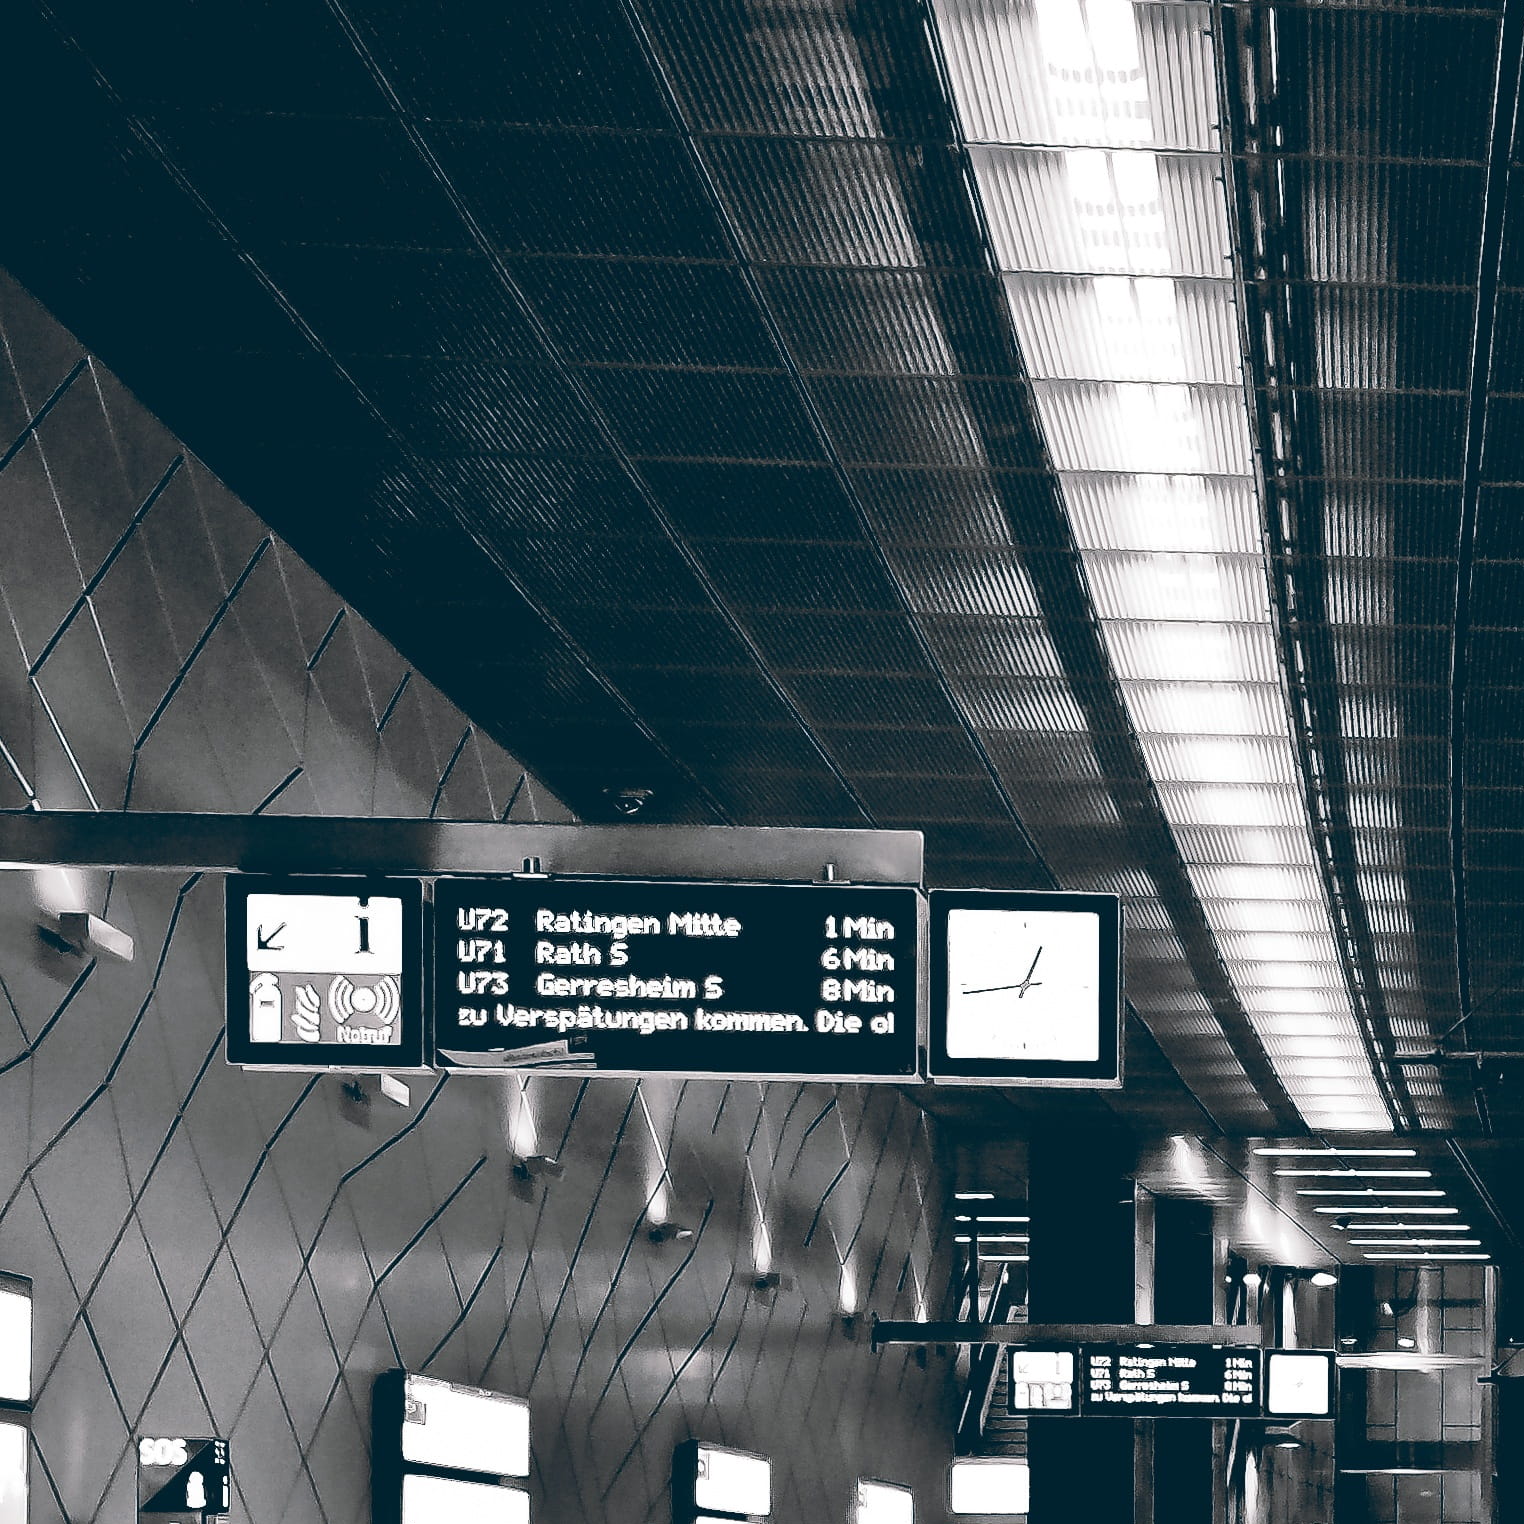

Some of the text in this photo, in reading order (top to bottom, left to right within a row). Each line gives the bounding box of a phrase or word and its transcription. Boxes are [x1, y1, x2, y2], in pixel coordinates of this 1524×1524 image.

[458, 908, 894, 939] U72 Ratingen Mitte 1 Min
[458, 939, 894, 970] U71 Rath S 6 Min
[459, 971, 509, 995] U73
[536, 973, 697, 998] Gerresheim
[704, 975, 724, 999] S
[843, 979, 894, 1002] Min
[458, 1008, 487, 1026] zu
[496, 1003, 688, 1034] Verspätungen
[694, 1008, 809, 1031] kommen.
[815, 1009, 862, 1033] Die
[139, 1438, 187, 1466] SOS
